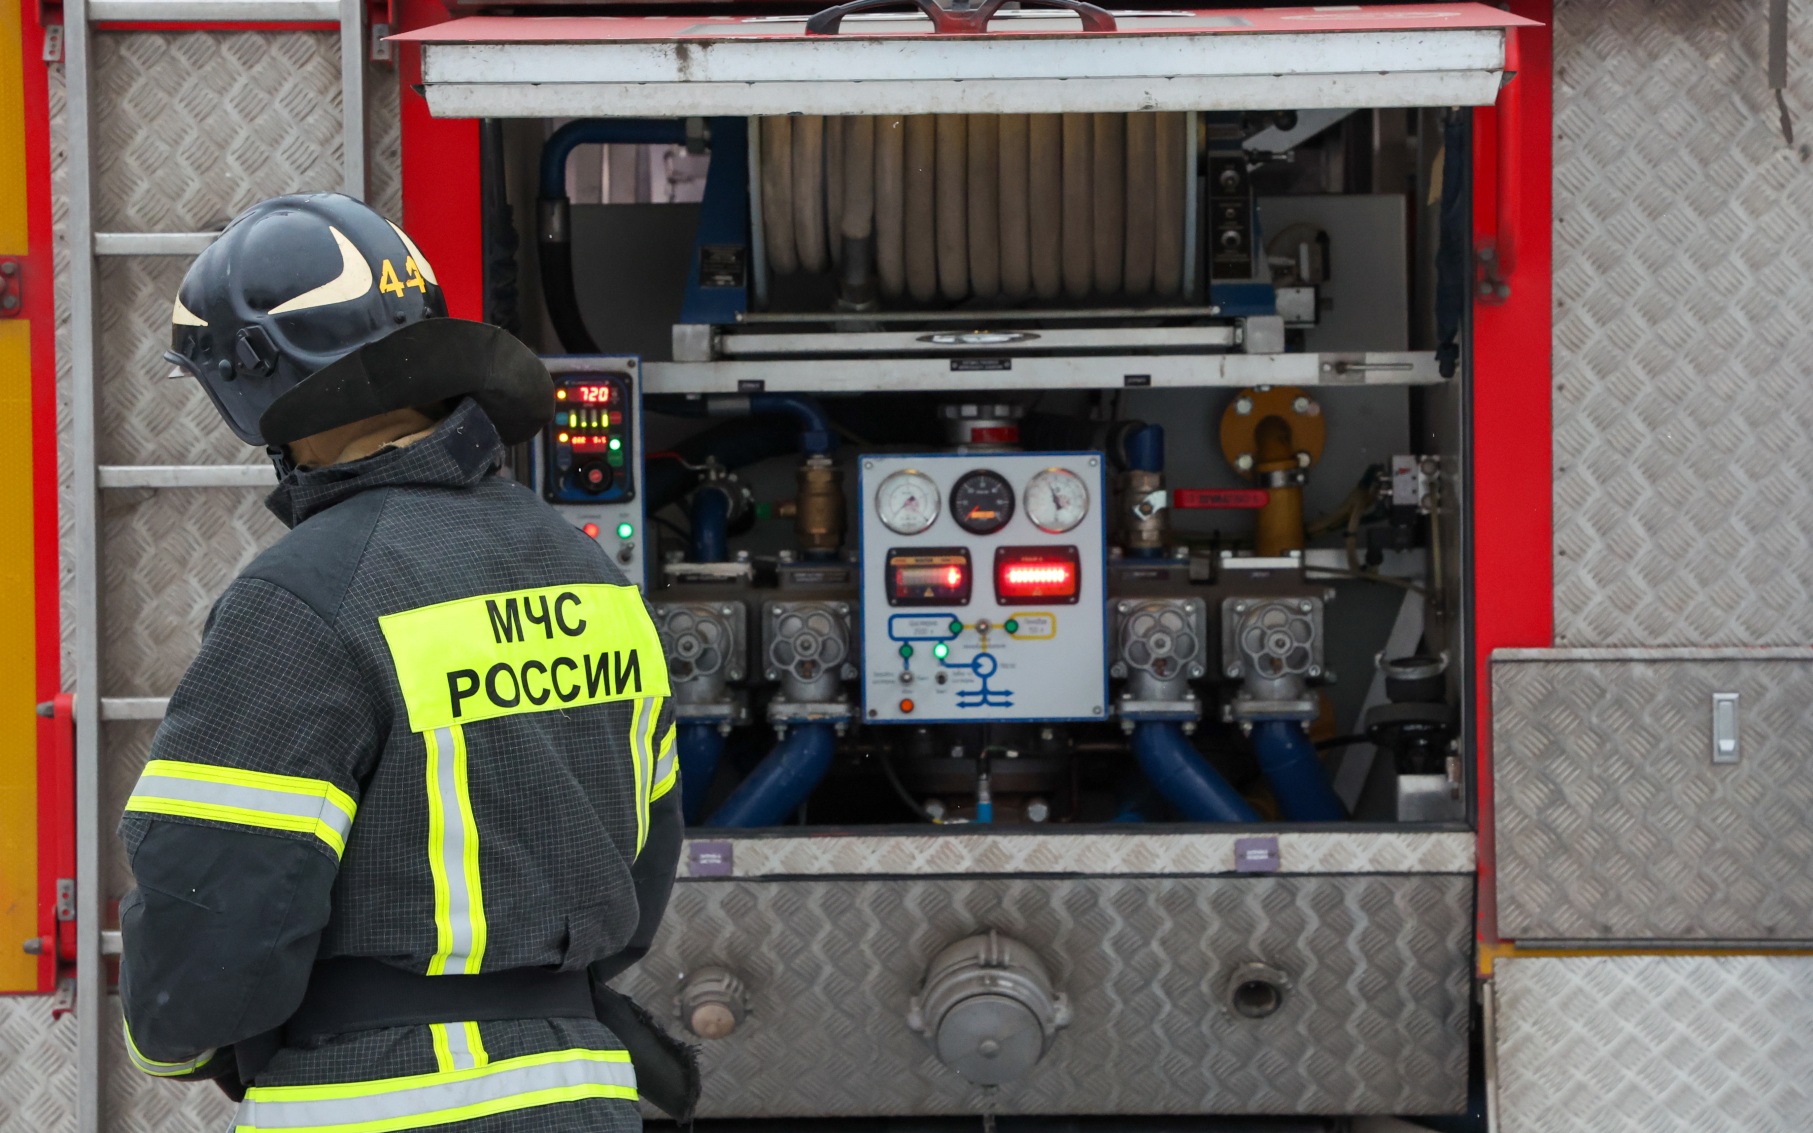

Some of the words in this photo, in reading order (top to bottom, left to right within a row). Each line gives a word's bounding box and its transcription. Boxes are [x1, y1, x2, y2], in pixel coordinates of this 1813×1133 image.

[580, 387, 609, 402] 720
[485, 592, 587, 644] МЧС
[447, 649, 642, 718] РОССИИ
